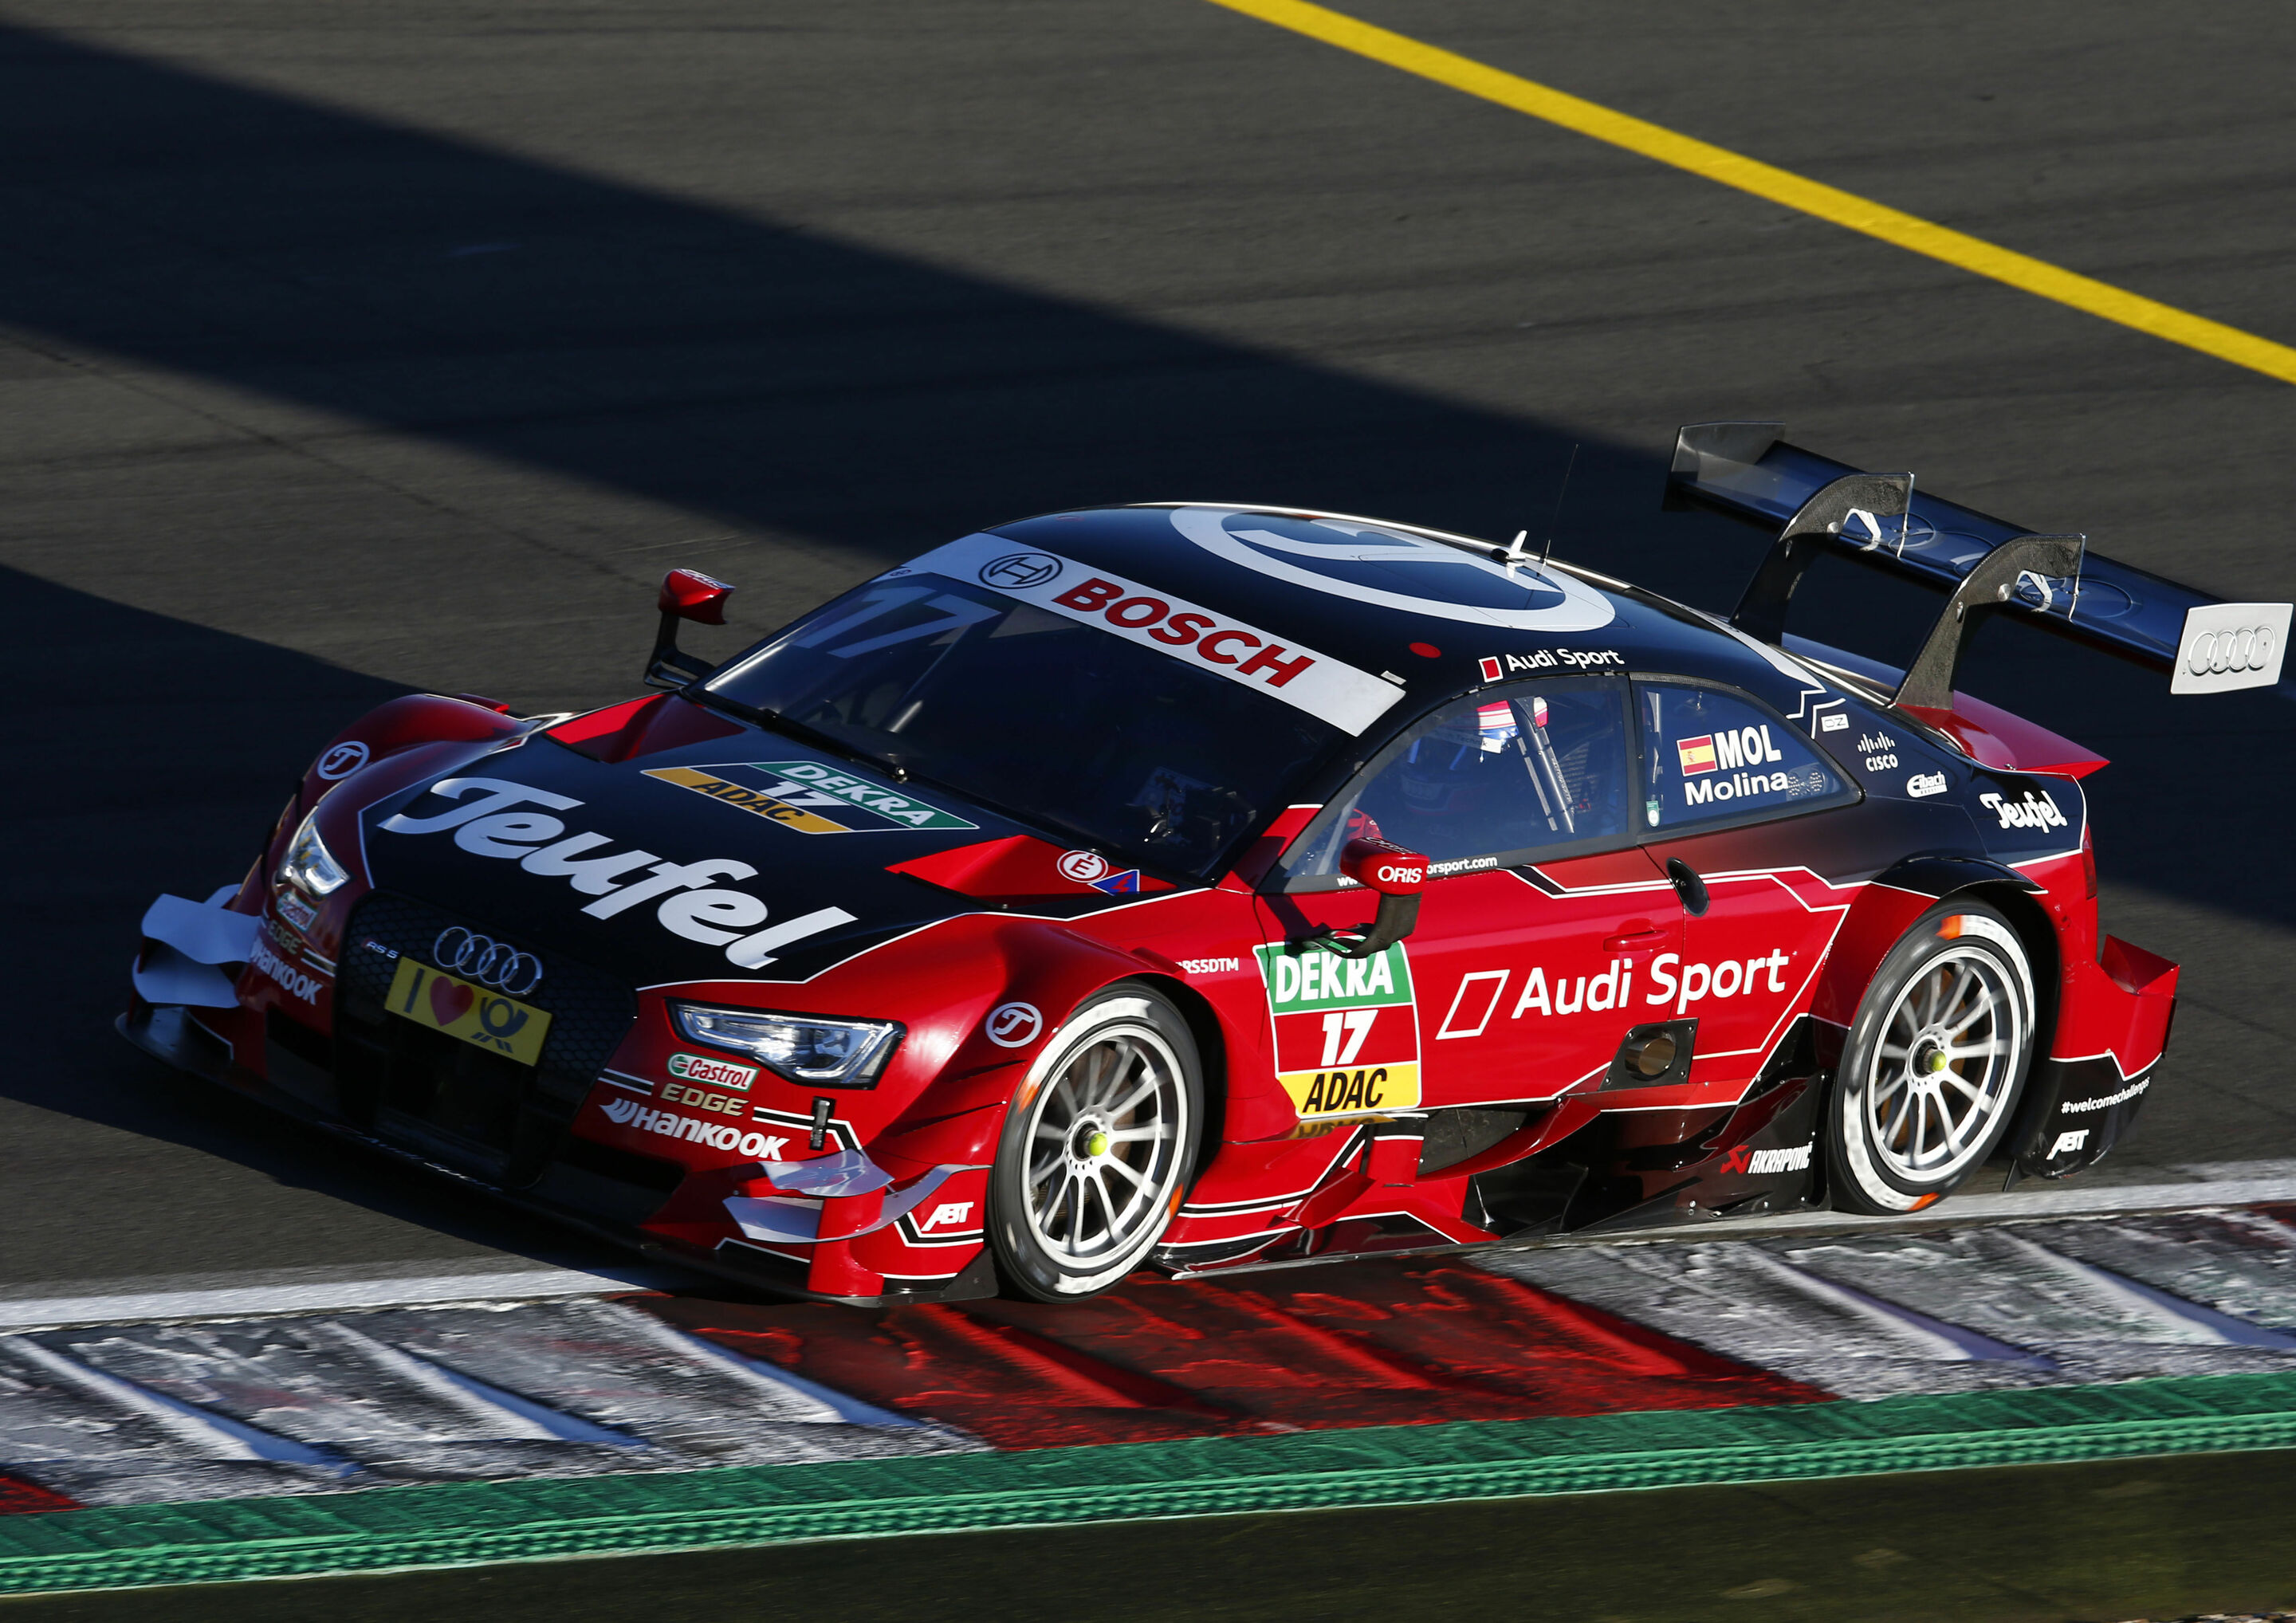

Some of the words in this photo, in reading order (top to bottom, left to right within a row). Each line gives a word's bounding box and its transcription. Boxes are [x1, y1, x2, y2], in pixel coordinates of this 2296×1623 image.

[1052, 576, 1316, 688] BOSCH
[1508, 652, 1556, 671] Audi
[1557, 649, 1625, 669] Sport
[1716, 724, 1782, 770] MOL
[692, 780, 805, 822] ADAC
[760, 780, 851, 807] 17
[784, 763, 936, 827] DEKRA
[1685, 769, 1789, 807] Molina
[1907, 770, 1946, 797] Eibach
[1979, 790, 2068, 834] Teufel
[377, 777, 859, 969] Teufel
[1378, 866, 1423, 884] ORIS
[268, 919, 302, 955] EDGE
[1175, 957, 1239, 974] RS5DTM
[1275, 948, 1394, 1004] DEKRA
[1512, 958, 1634, 1020] Audi
[1646, 948, 1788, 1015] Sport
[1321, 1009, 1378, 1067] 17
[688, 1059, 752, 1087] Castrol
[1303, 1068, 1387, 1113] ADAC
[659, 1083, 749, 1117] EDGE
[2061, 1076, 2150, 1114] #welcomechallenges
[2046, 1129, 2090, 1160] ABT
[921, 1201, 974, 1232] ABT
